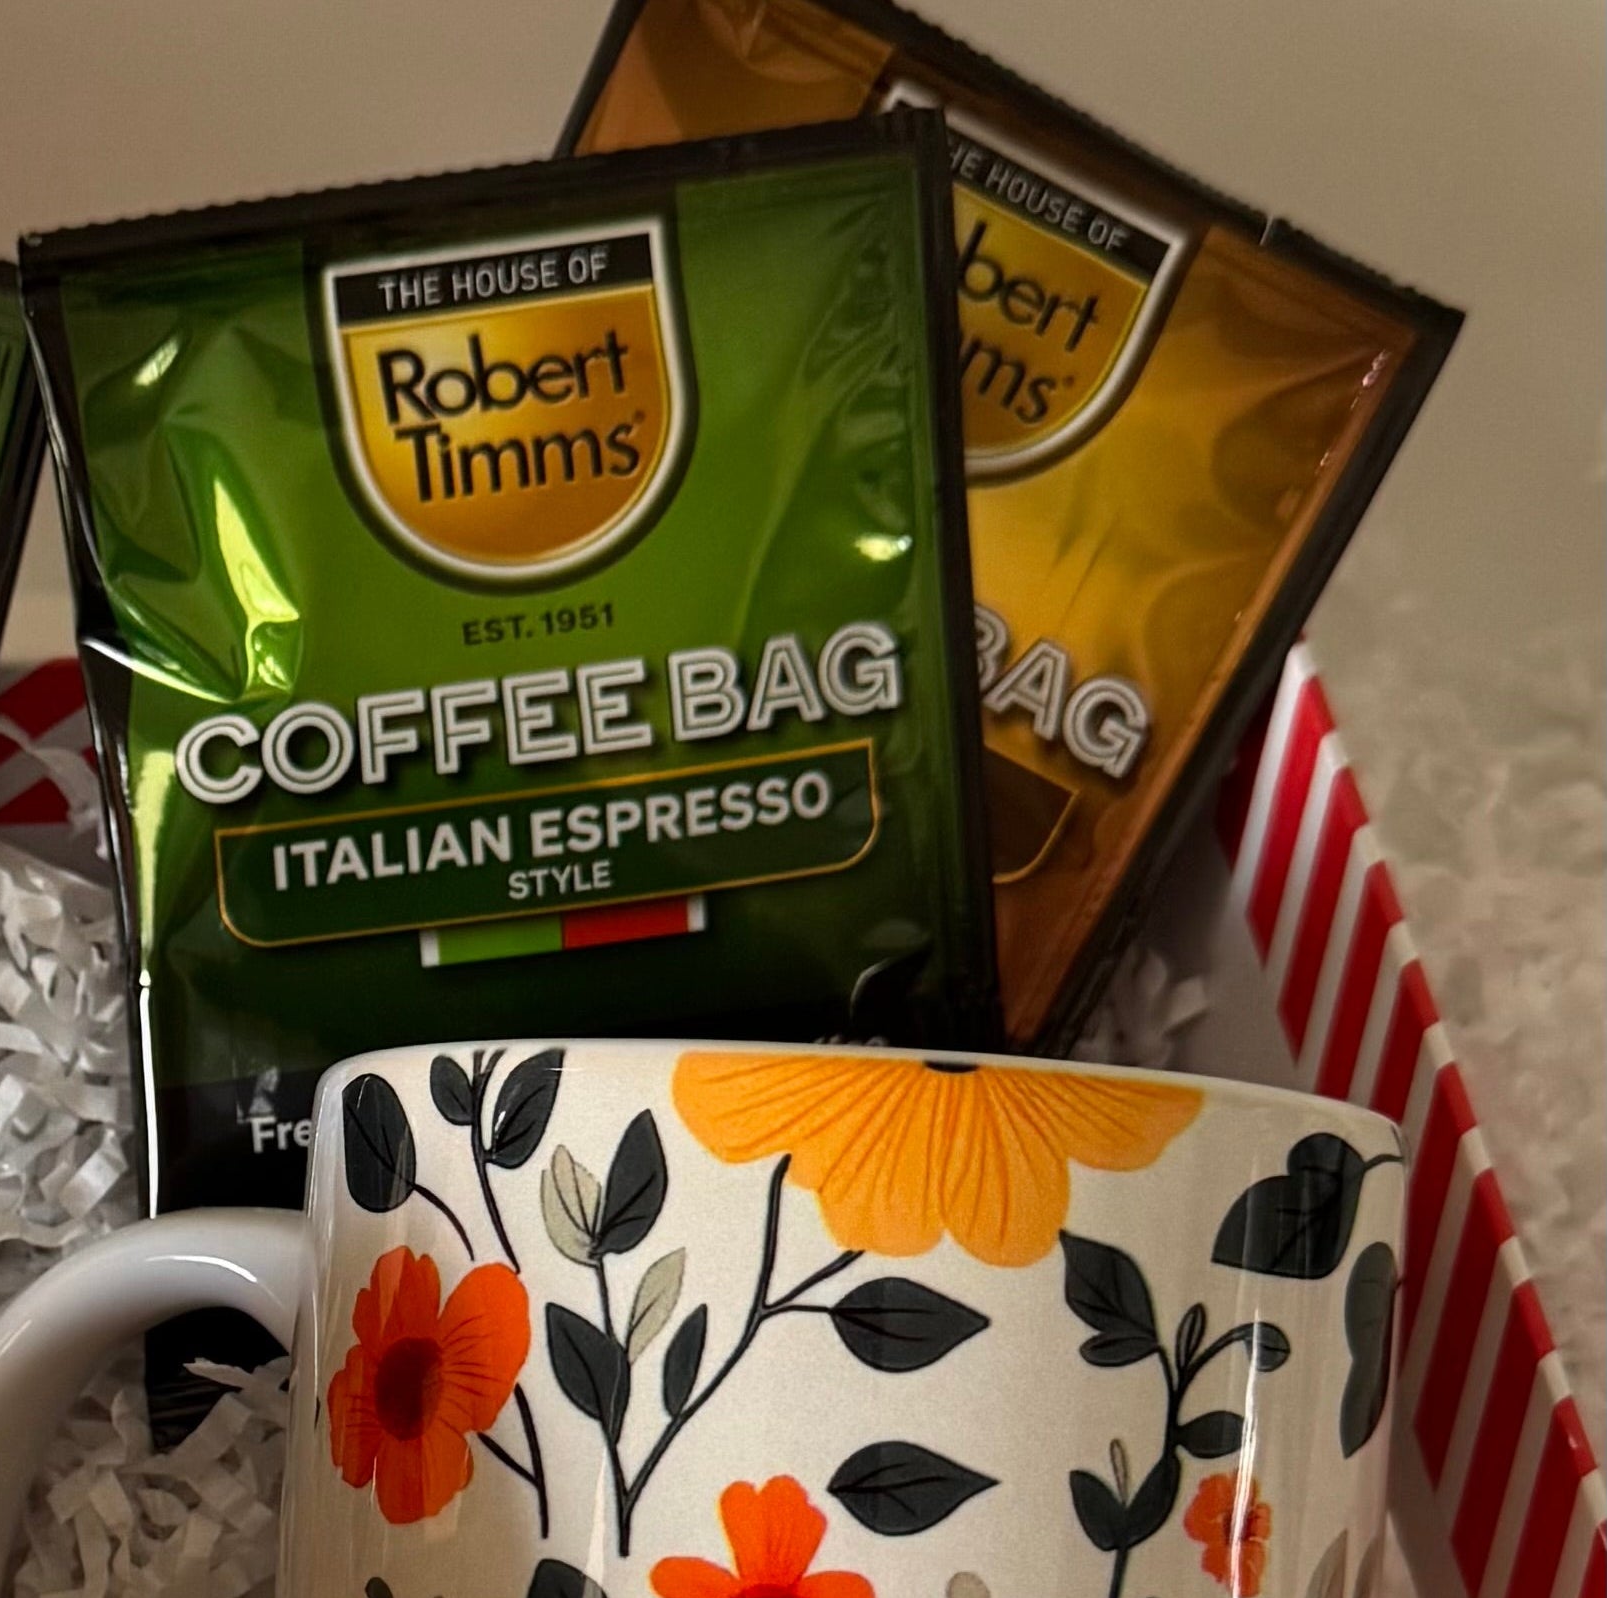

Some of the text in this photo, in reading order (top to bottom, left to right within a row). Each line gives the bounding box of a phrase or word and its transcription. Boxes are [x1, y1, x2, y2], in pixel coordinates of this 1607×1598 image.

[985, 163, 1085, 234] HOUSE
[1087, 218, 1130, 251] OF
[377, 247, 609, 312] THE HOUSE OF
[957, 220, 1099, 352] bert
[376, 330, 628, 424] Robert
[395, 424, 640, 502] Timms
[461, 603, 614, 646] EST. 1951
[176, 621, 902, 804] COFFEE BAG
[272, 770, 831, 892] ITALIAN ESPRESSO
[507, 861, 613, 902] STYLE
[249, 1116, 313, 1154] Fre
